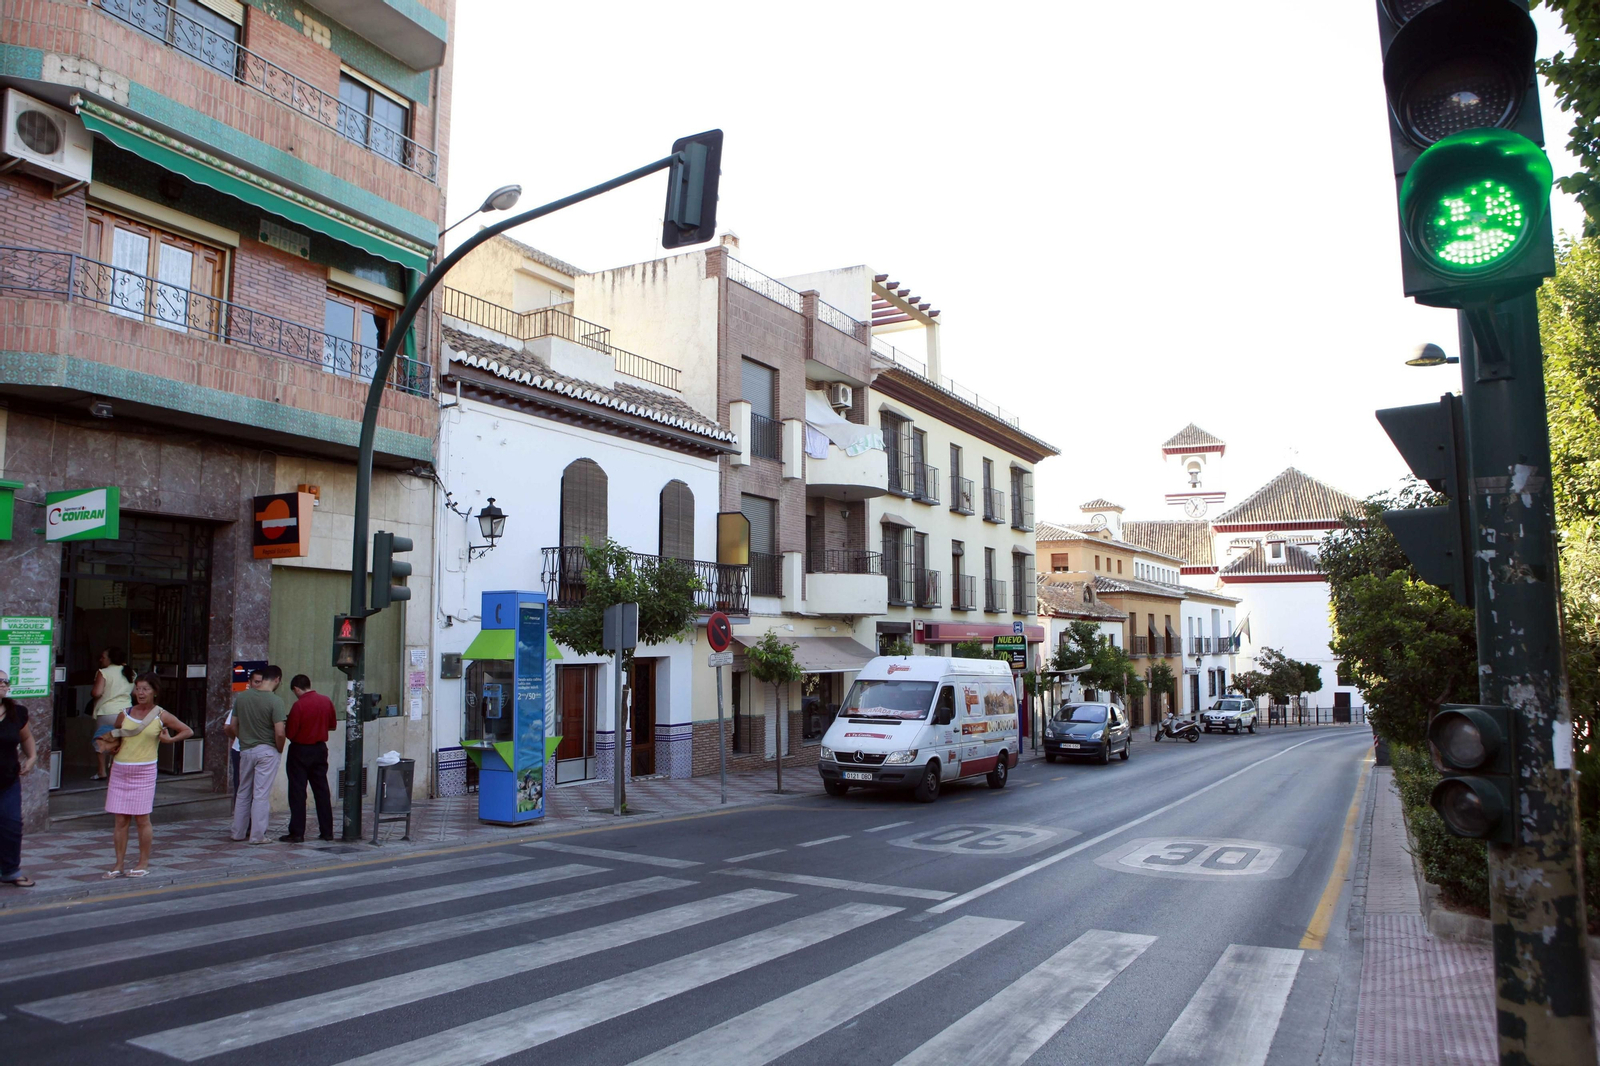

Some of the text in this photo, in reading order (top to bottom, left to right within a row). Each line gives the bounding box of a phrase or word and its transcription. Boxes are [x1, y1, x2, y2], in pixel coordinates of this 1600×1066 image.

[62, 509, 105, 522] COVIRAN
[912, 826, 1036, 850] 30
[1142, 843, 1261, 870] 30
